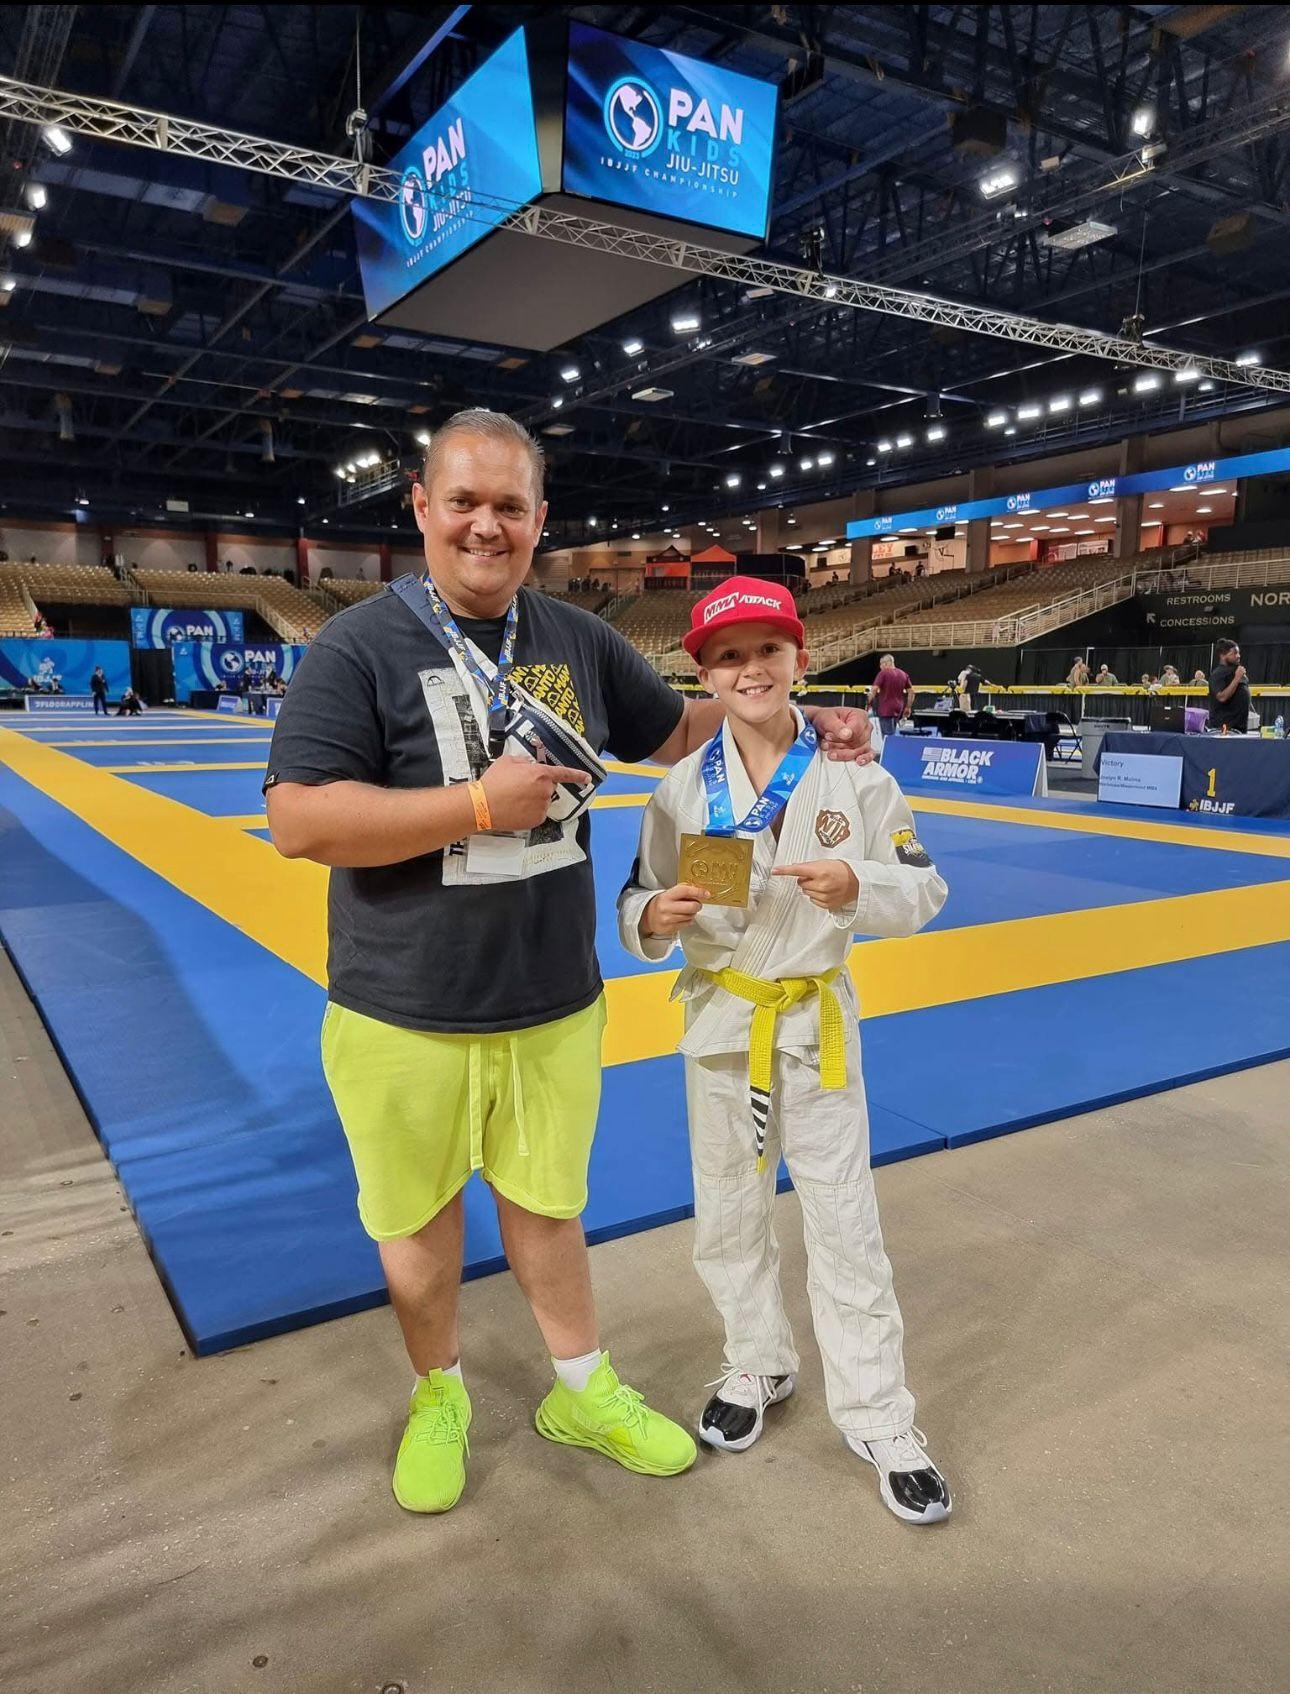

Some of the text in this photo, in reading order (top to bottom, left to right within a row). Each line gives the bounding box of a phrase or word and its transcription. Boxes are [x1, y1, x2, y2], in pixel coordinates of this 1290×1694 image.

[669, 88, 744, 145] PAN
[422, 117, 466, 190] PAN
[667, 128, 741, 167] KIDS
[600, 156, 738, 198] IBJJF CHAMPIONSHIP
[666, 153, 739, 185] JIU-JITSU
[1197, 462, 1215, 472] PAN
[1100, 479, 1116, 489] PAN
[1016, 493, 1030, 502] PAN
[739, 594, 782, 610] ATTACK
[1166, 593, 1231, 605] RESTROOMS
[1250, 592, 1290, 607] NOR
[186, 625, 214, 636] PAN
[1160, 616, 1235, 628] CONCESSIONS
[244, 650, 276, 663] PAN
[532, 669, 556, 699] ANTO
[38, 700, 95, 708] FLOGRAPPLIN
[554, 687, 575, 716] ANTO
[940, 748, 994, 766] BLACK
[1101, 760, 1124, 768] Victory
[714, 759, 725, 783] PAN
[923, 761, 979, 779] ARMOR
[1206, 768, 1216, 797] 1
[751, 796, 770, 816] PAN
[1200, 799, 1235, 814] IBJJF
